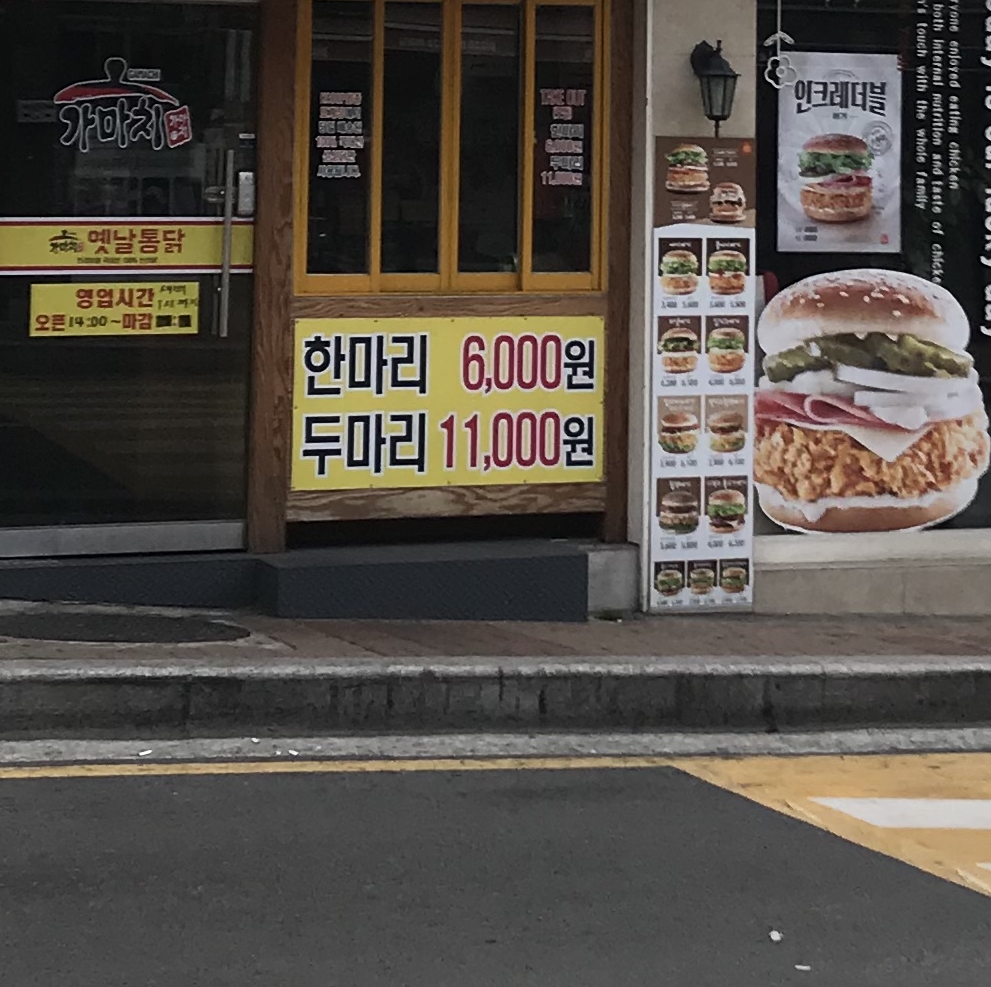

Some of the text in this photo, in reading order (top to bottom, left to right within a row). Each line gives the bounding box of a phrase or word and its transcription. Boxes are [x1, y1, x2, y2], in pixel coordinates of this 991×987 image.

[932, 3, 945, 32] both
[916, 22, 928, 57] touch
[916, 65, 929, 92] with
[948, 40, 962, 88] enjoyed
[794, 79, 887, 117] 인크레더블
[916, 100, 928, 120] the
[948, 95, 962, 134] eating
[59, 97, 165, 153] 가마치
[932, 93, 945, 146] nutrition
[915, 128, 928, 163] whole
[932, 153, 945, 176] and
[948, 141, 962, 190] chicken
[915, 171, 928, 210] family
[931, 180, 945, 214] taste
[87, 228, 186, 255] 옛날통닭
[931, 221, 945, 236] of
[931, 243, 945, 284] chicke
[75, 287, 155, 310] 영업시간
[35, 314, 66, 332] 오픈
[304, 334, 595, 396] 한마리 6,000원
[302, 411, 594, 476] 두마리 11,000원
